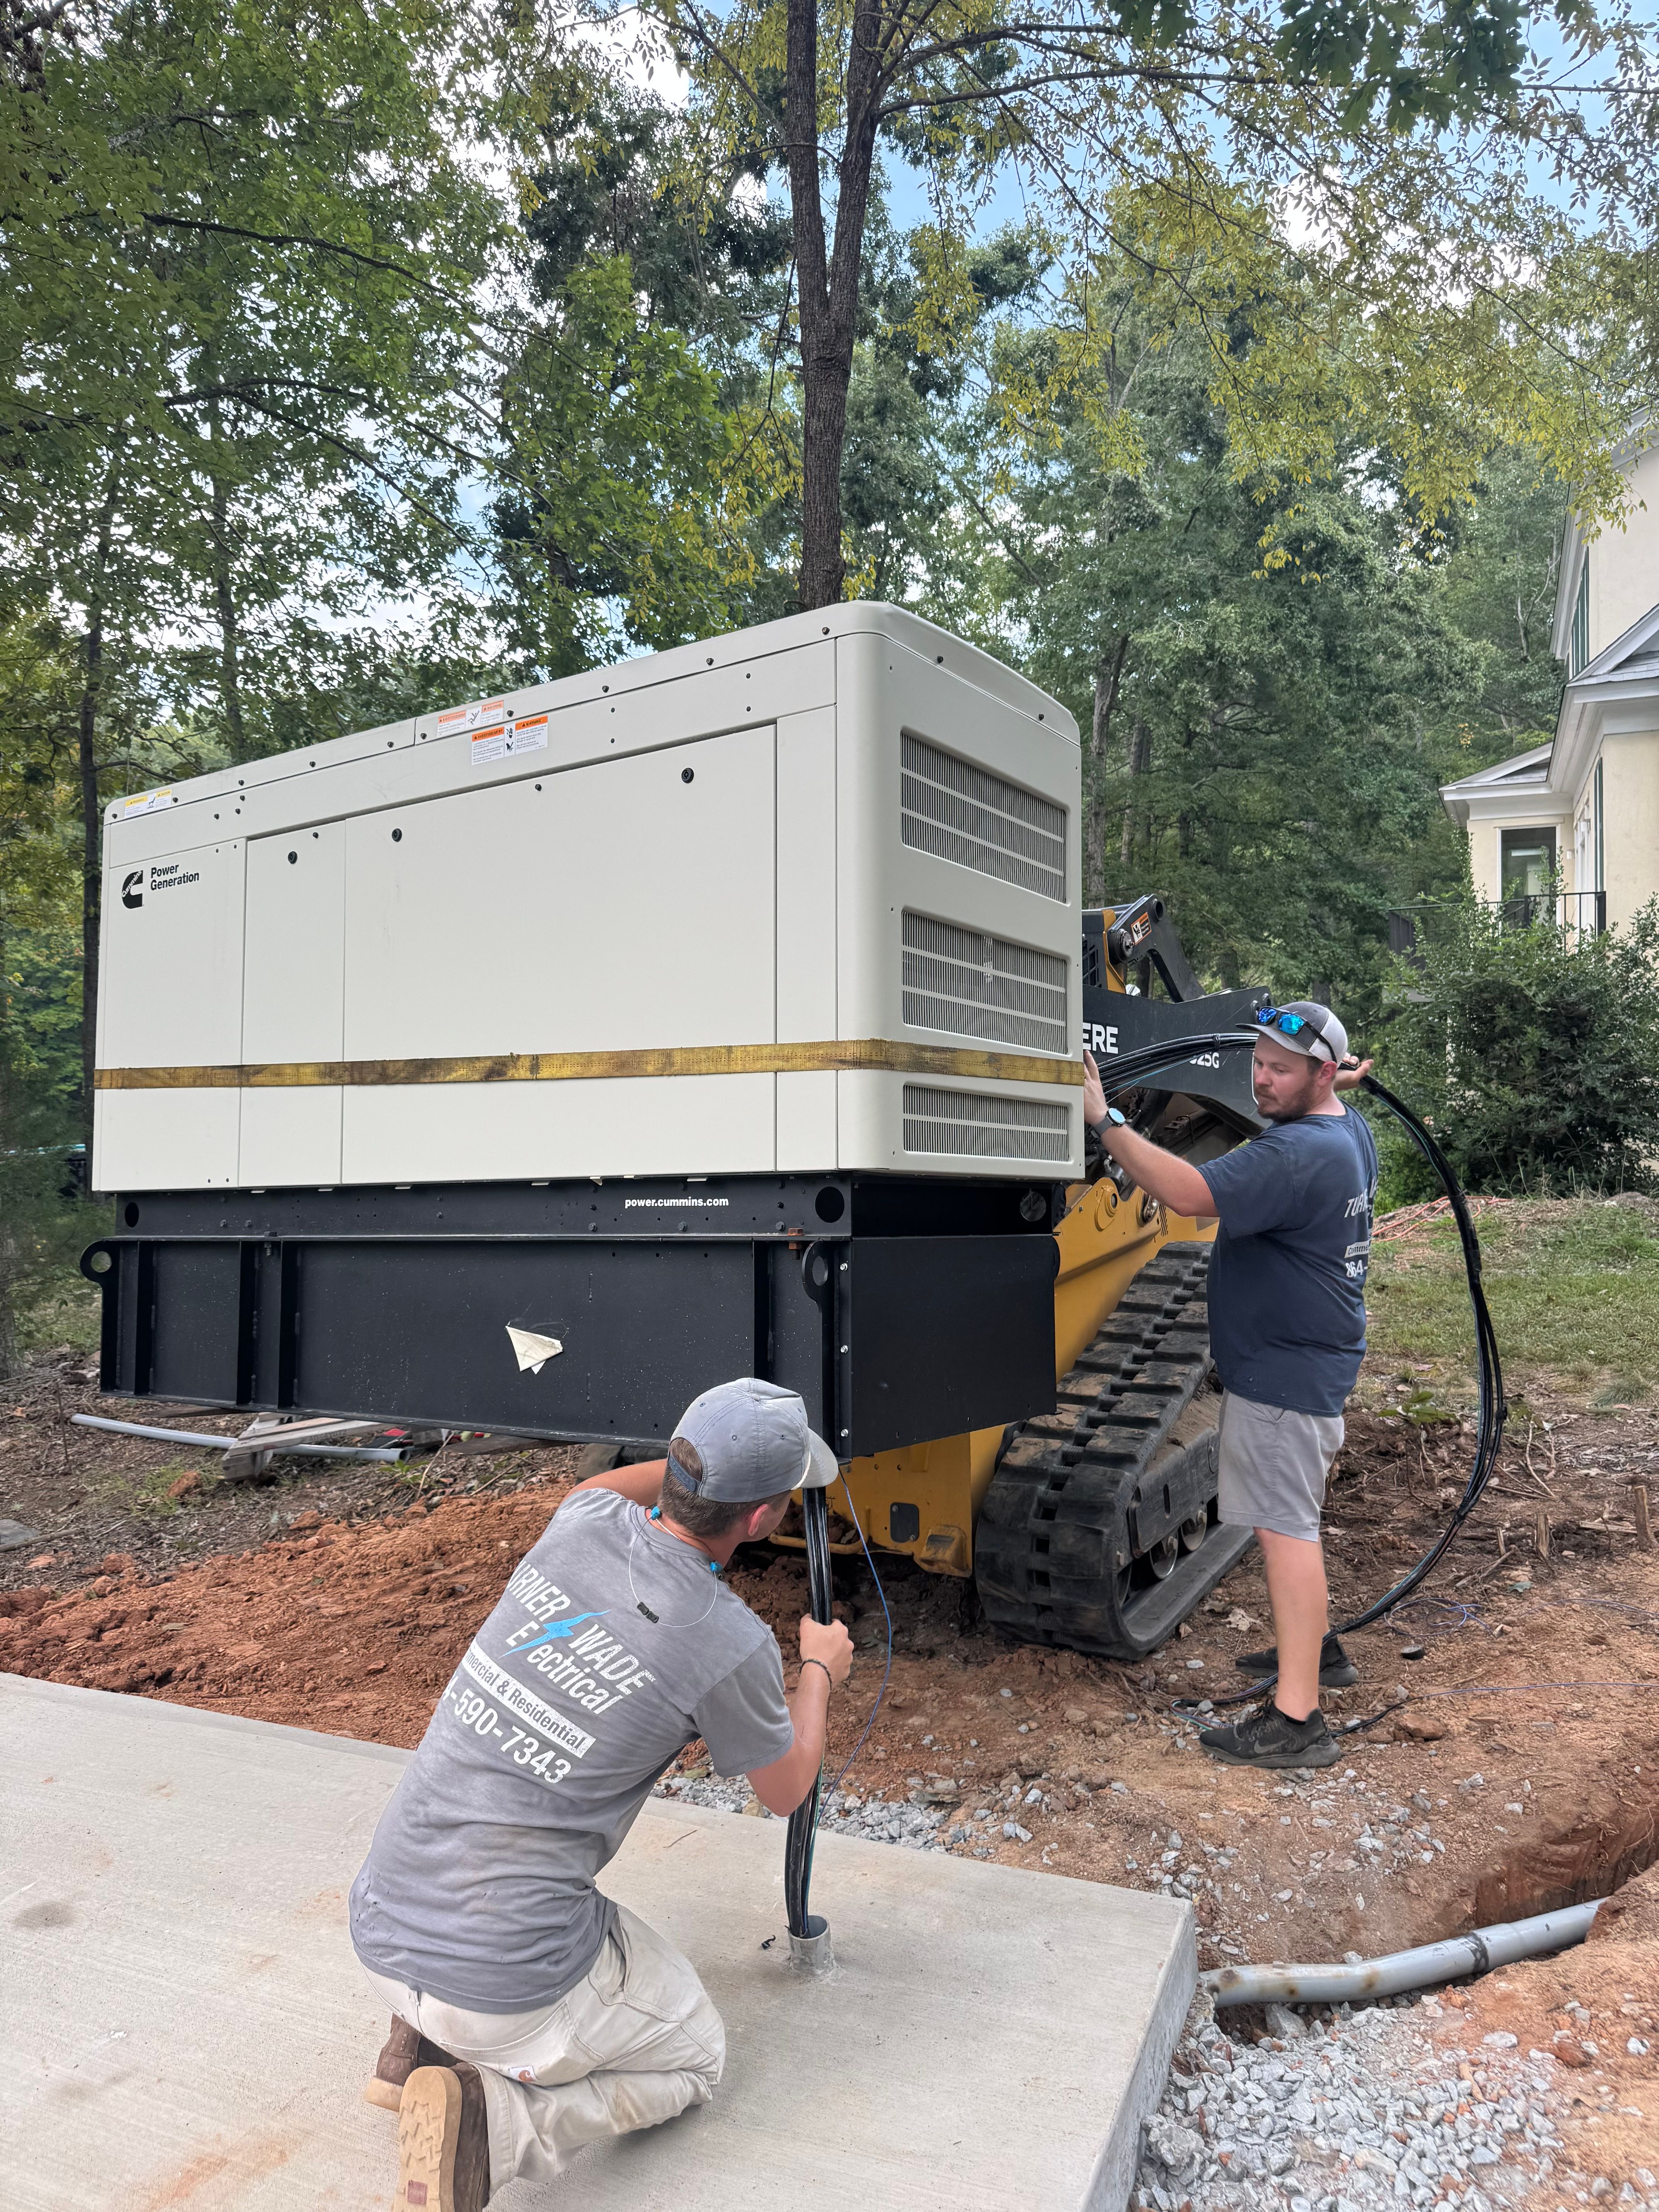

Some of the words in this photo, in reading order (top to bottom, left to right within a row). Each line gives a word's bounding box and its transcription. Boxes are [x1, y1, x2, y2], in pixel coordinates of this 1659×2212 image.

[151, 864, 179, 878] Power
[122, 871, 142, 898] Cummins
[151, 872, 199, 891] Generation
[625, 1196, 729, 1209] power.cummins.com
[1345, 1260, 1368, 1278] 864-
[568, 1623, 656, 1696] WADE
[497, 1679, 510, 1695] &
[508, 1690, 586, 1750] Residential
